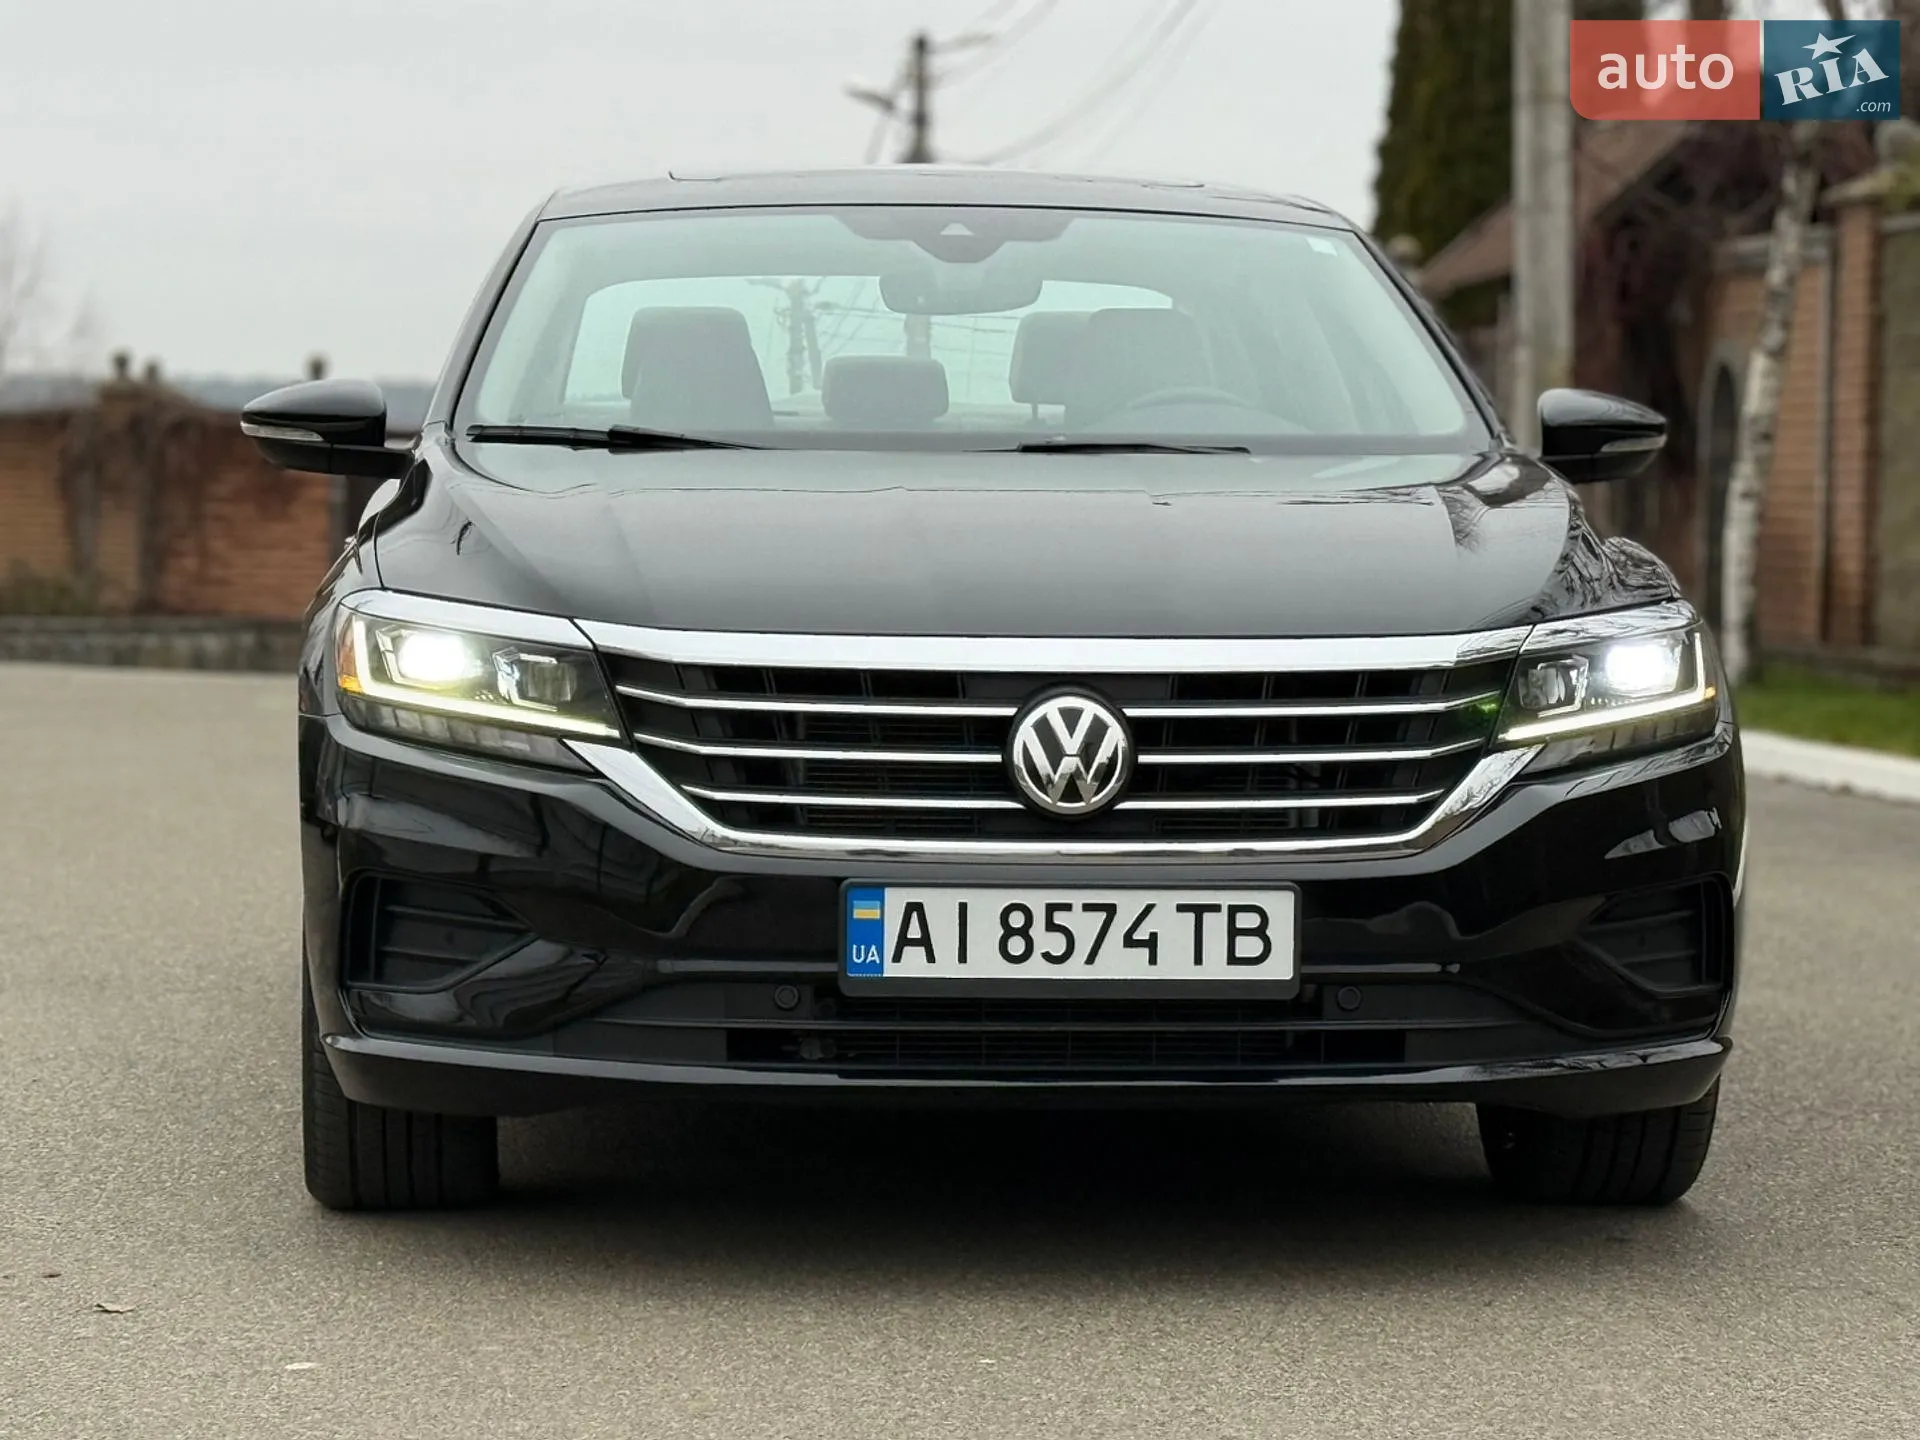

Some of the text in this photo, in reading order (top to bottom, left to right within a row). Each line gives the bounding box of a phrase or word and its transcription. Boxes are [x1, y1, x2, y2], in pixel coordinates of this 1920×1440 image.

[852, 944, 881, 965] UA
[891, 901, 1273, 966] AI 8574 TB
